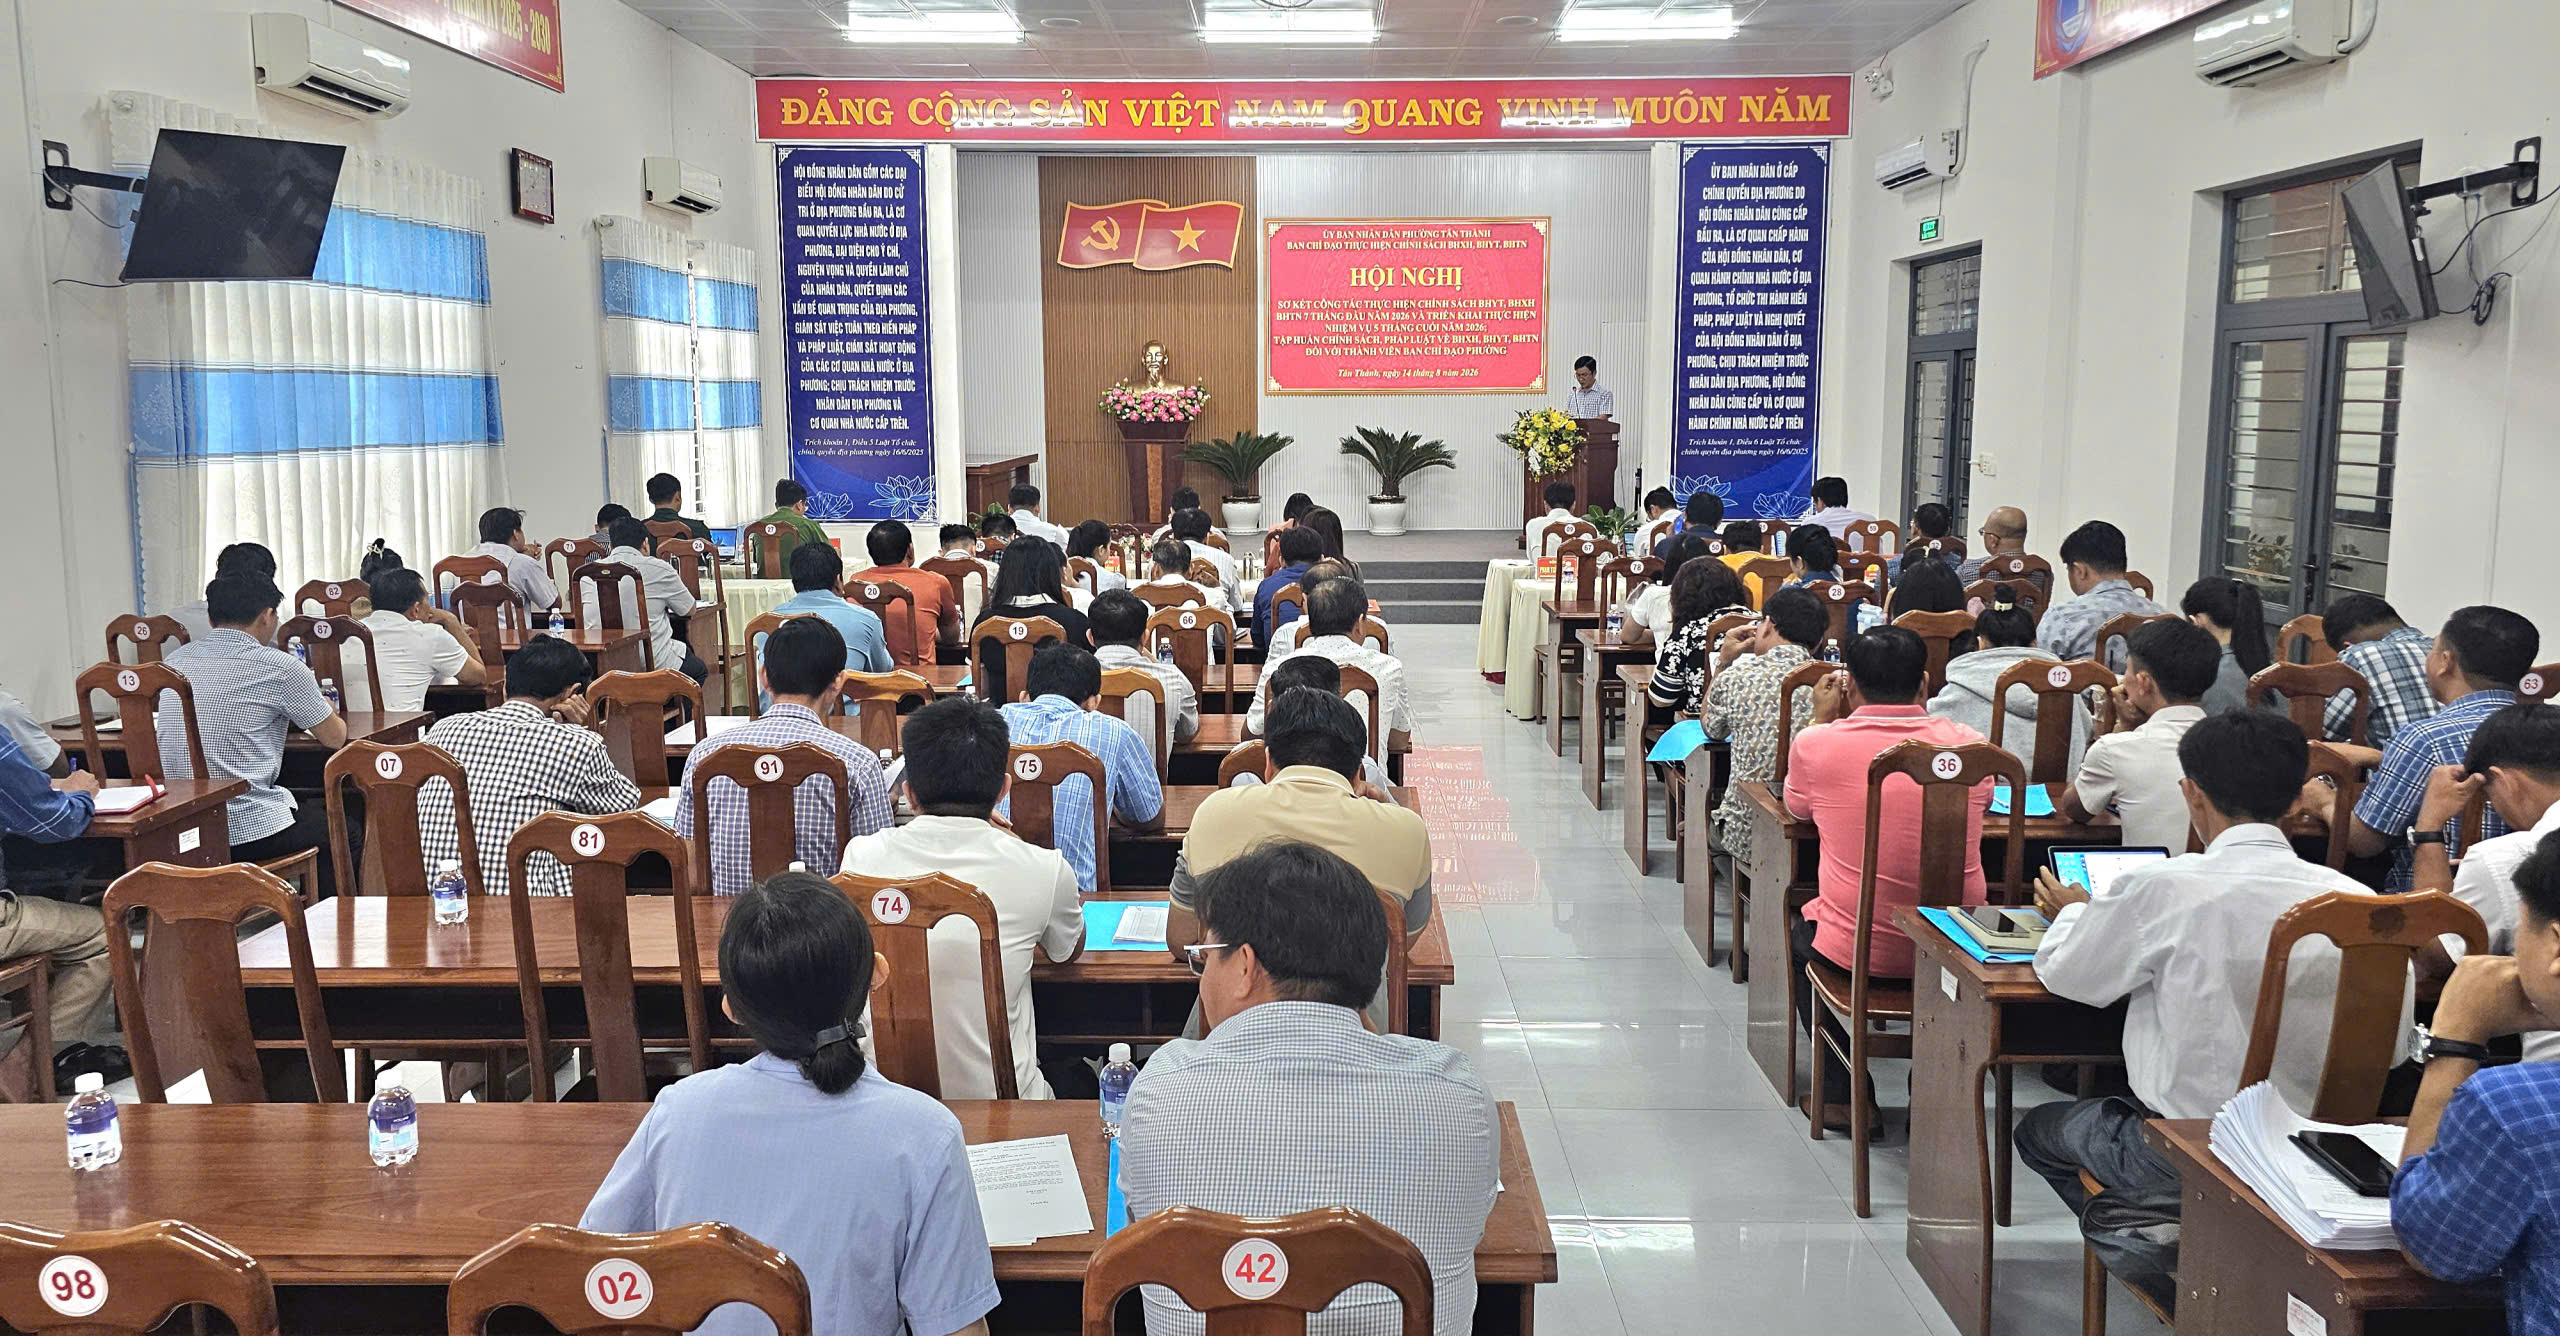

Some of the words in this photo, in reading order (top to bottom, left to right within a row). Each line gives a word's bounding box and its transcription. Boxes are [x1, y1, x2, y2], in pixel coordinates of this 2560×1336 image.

[529, 9, 551, 55] 2030
[781, 88, 894, 126] ĐẢNG
[908, 90, 1015, 134] CỘNG
[1029, 88, 1109, 128] SẢN
[1122, 91, 1220, 134] VIỆT
[1236, 97, 1328, 128] NAM
[1343, 98, 1483, 134] QUANG
[1497, 97, 1599, 125] VINH
[1613, 88, 1726, 125] MUÔN
[1738, 87, 1831, 122] NĂM
[1350, 264, 1395, 292] HỘI
[1401, 266, 1463, 291] NGHỊ
[329, 587, 339, 596] 82
[867, 588, 877, 596] 20
[1183, 616, 1193, 625] 66
[137, 626, 147, 635] 26
[318, 625, 328, 634] 87
[1013, 626, 1023, 636] 19
[122, 674, 135, 686] 13
[2053, 671, 2067, 682] 112
[2524, 679, 2538, 690] 63
[381, 758, 397, 772] 07
[760, 760, 778, 774] 91
[1018, 760, 1037, 774] 75
[1938, 758, 1957, 771] 36
[578, 831, 598, 848] 81
[878, 896, 903, 916] 74
[1235, 1253, 1276, 1284] 42
[52, 1269, 95, 1302] 98
[598, 1271, 642, 1305] 02
